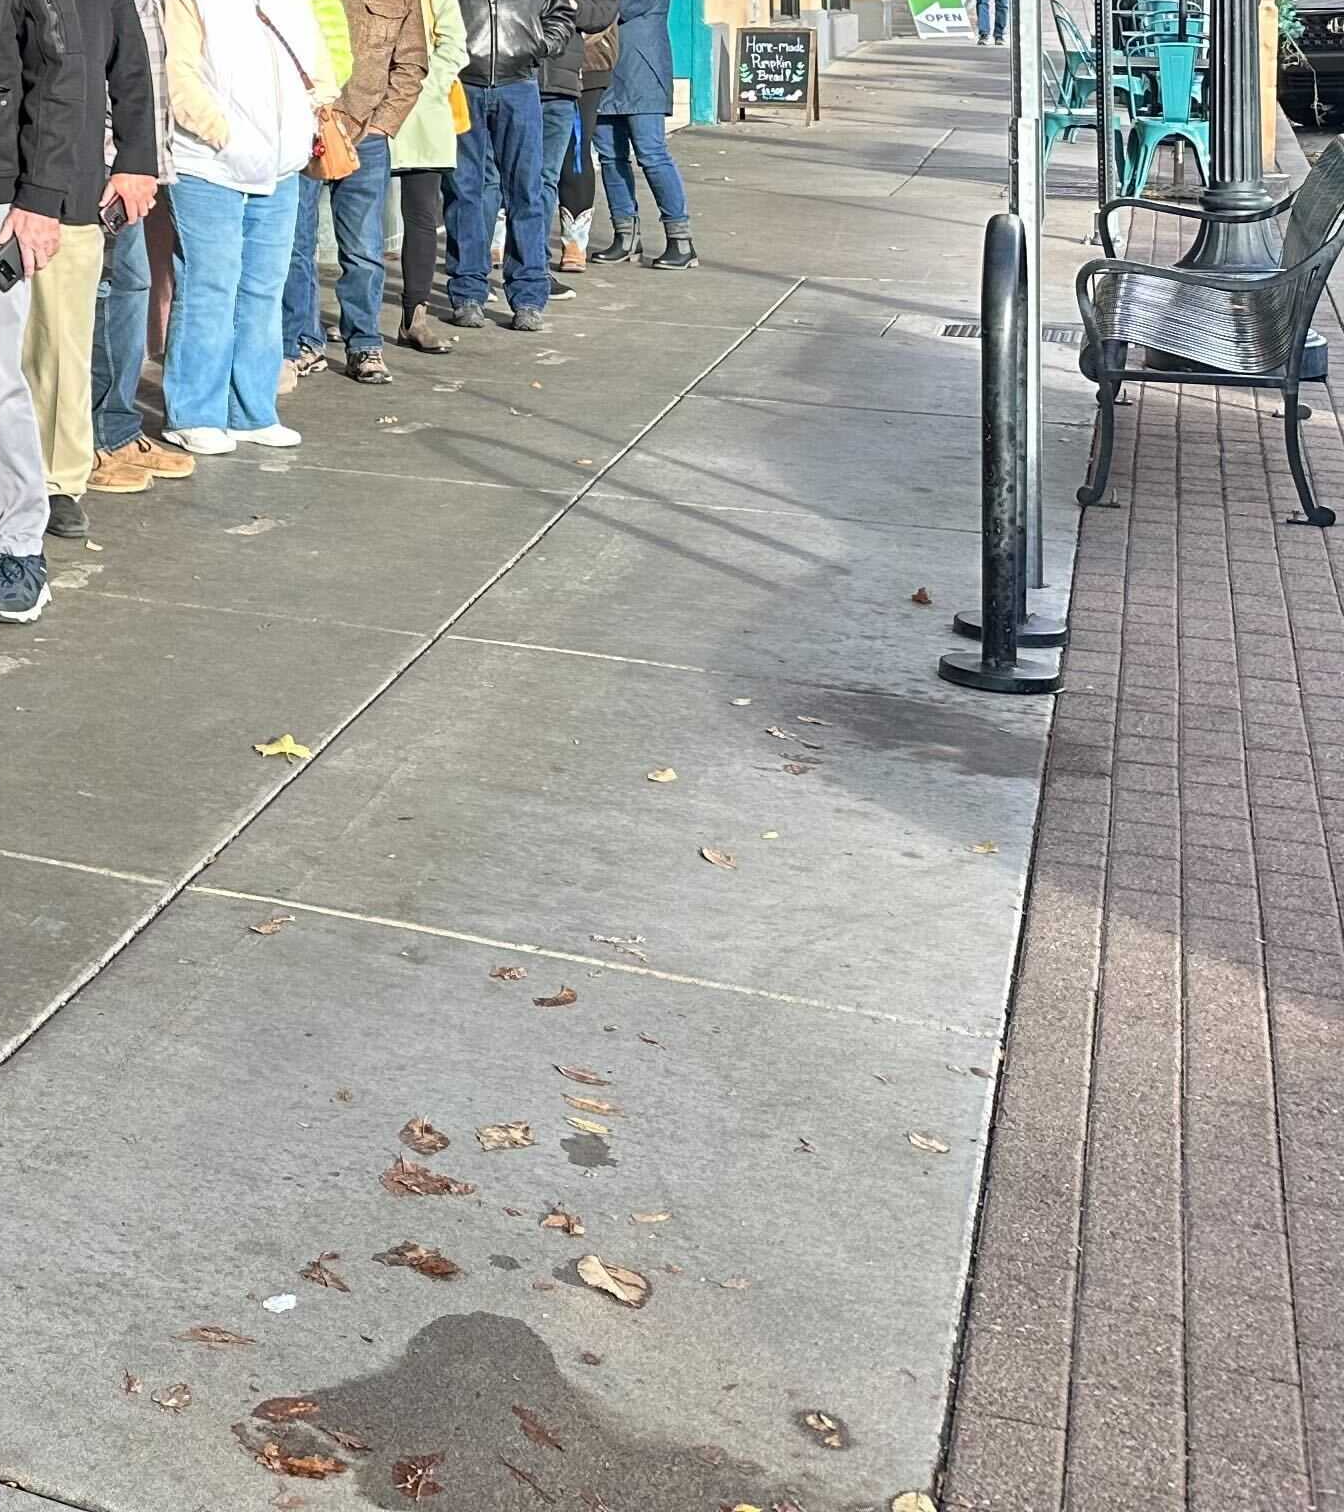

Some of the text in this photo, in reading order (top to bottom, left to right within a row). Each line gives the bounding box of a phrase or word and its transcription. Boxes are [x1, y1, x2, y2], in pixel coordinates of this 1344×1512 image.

[925, 13, 963, 22] OPEN
[745, 34, 805, 53] Home-made
[750, 53, 792, 72] Pumpkin
